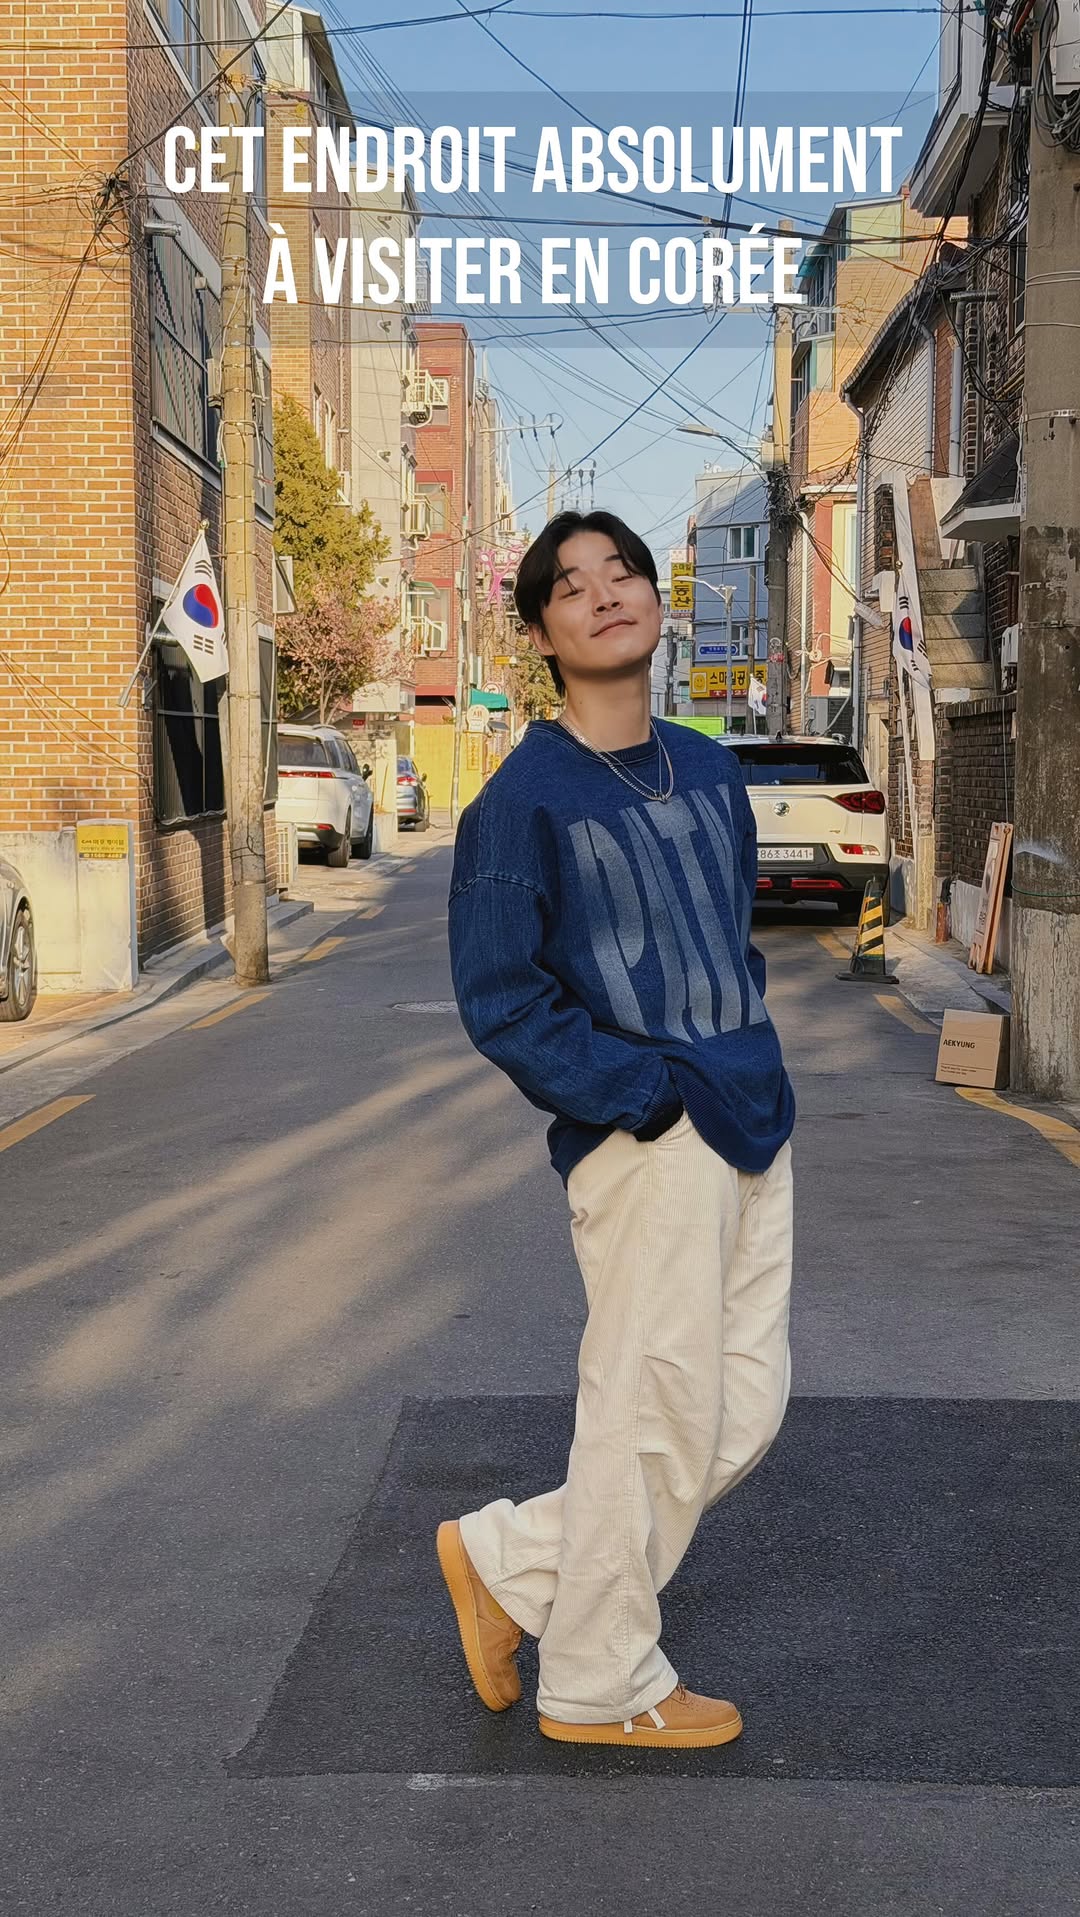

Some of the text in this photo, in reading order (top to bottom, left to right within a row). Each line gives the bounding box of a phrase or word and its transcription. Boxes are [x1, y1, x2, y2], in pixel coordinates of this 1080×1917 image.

[757, 849, 809, 859] 86조 3441
[943, 1039, 976, 1049] AEKYUNG
